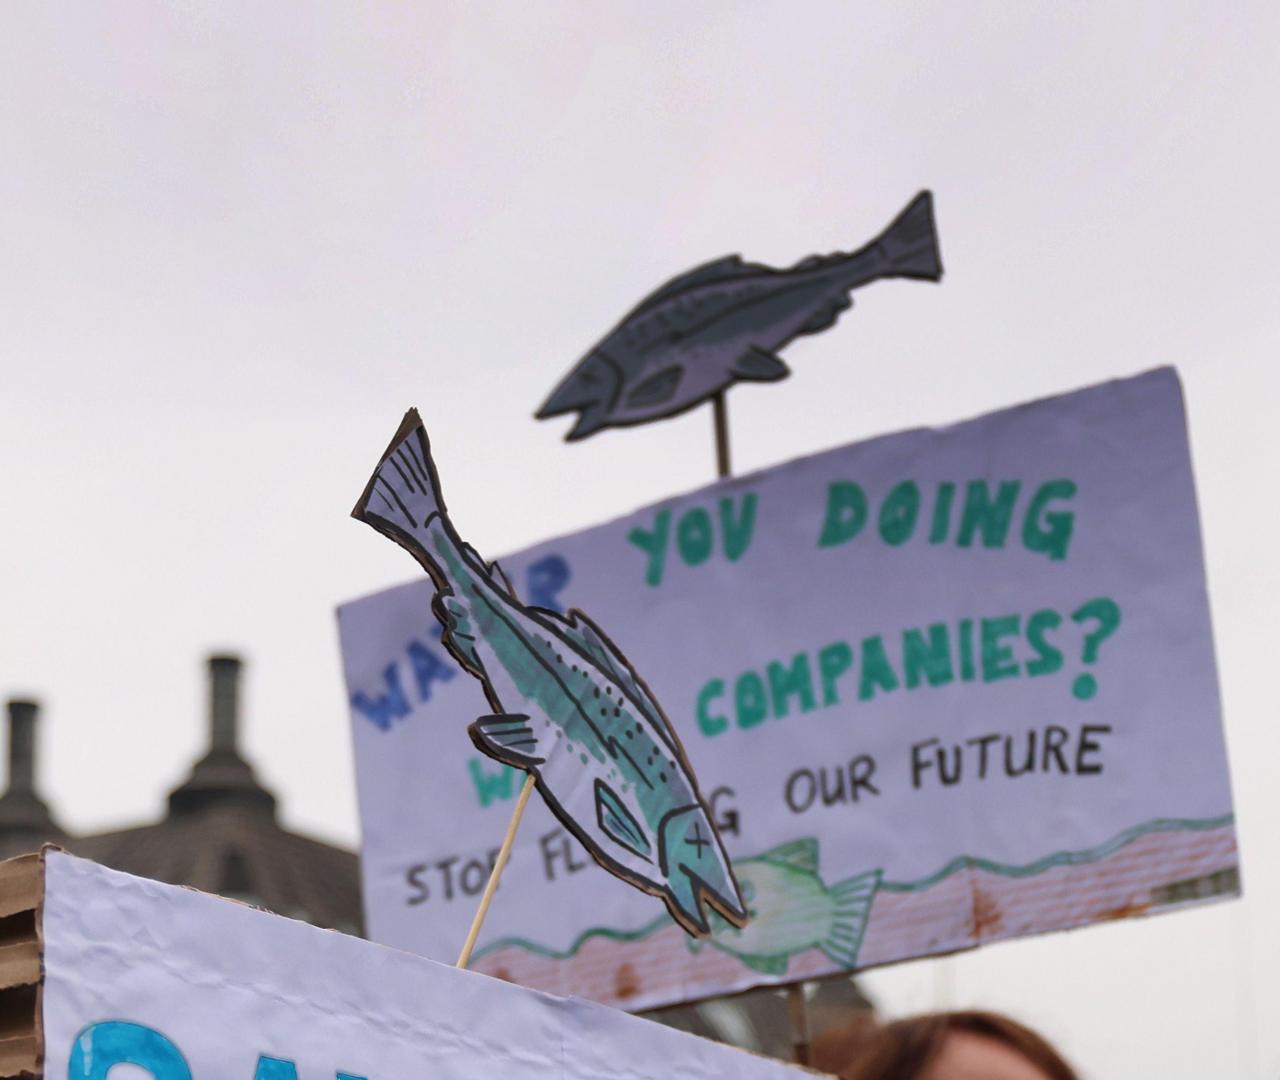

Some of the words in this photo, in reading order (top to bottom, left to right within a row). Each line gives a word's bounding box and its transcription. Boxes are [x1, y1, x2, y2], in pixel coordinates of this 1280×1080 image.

[626, 492, 759, 588] YOU
[817, 477, 1079, 562] DOING
[693, 596, 1122, 738] COMPANIES?
[784, 755, 880, 814] OUR
[910, 724, 1113, 789] FUTURE
